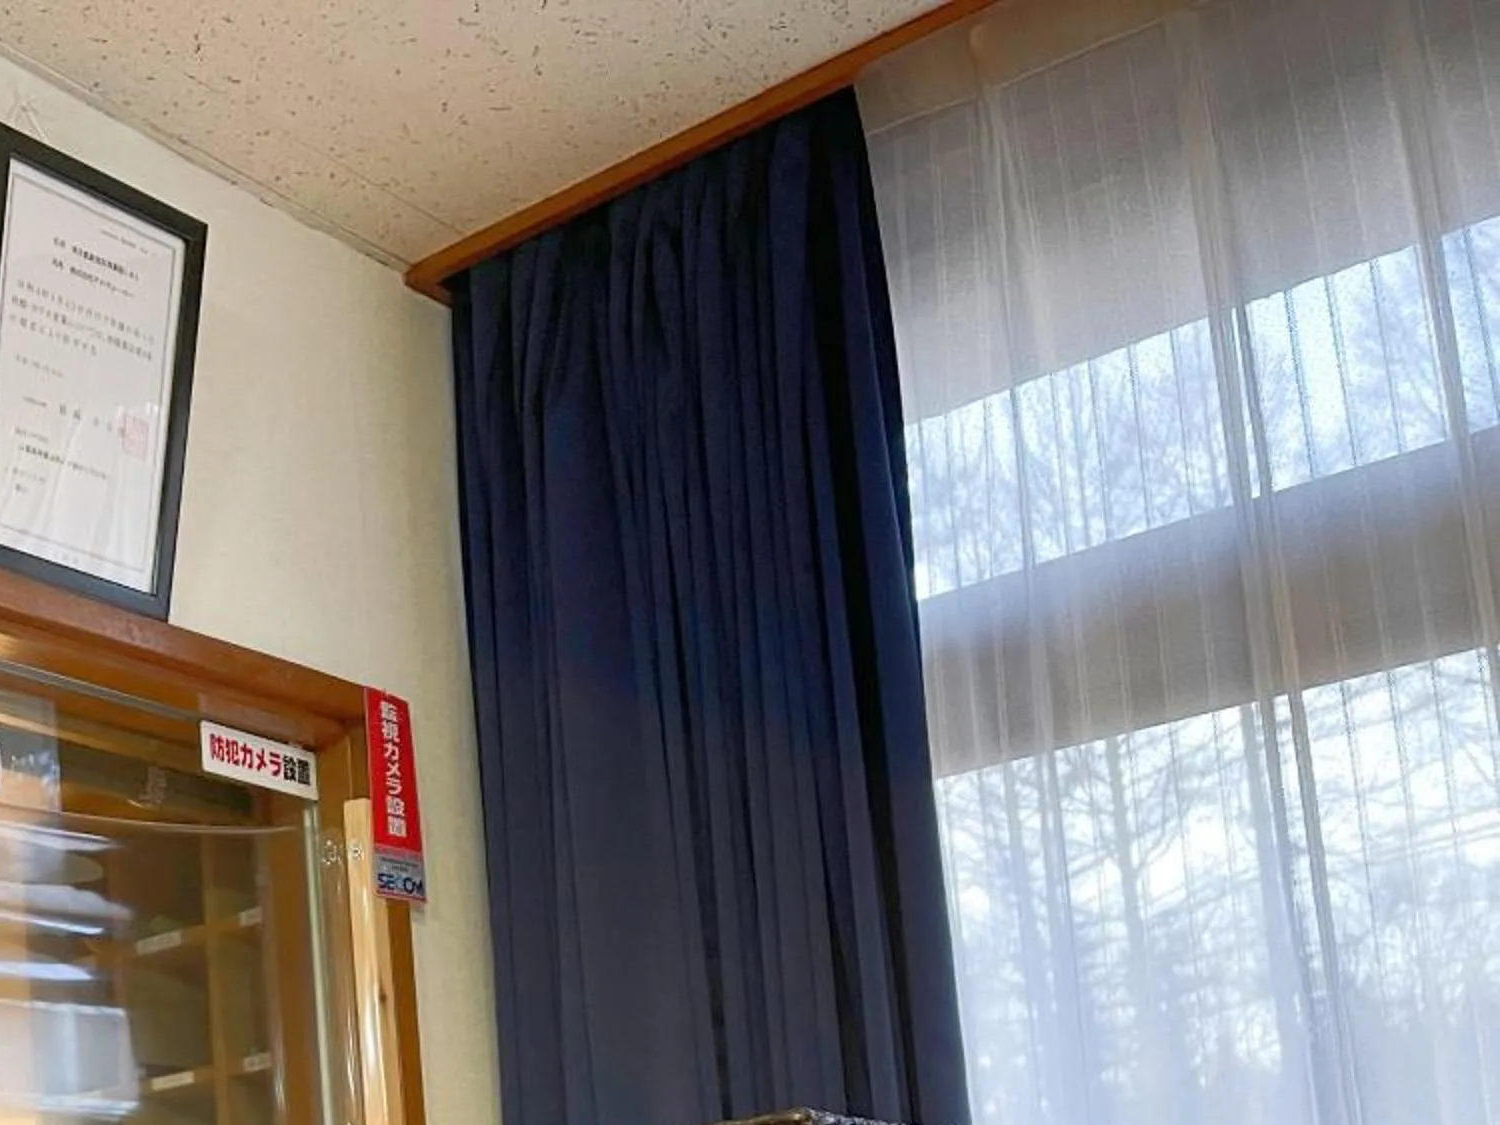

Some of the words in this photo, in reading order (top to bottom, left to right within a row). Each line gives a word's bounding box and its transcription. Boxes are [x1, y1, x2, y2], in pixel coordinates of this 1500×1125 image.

[209, 733, 311, 786] 防犯カメラ設置
